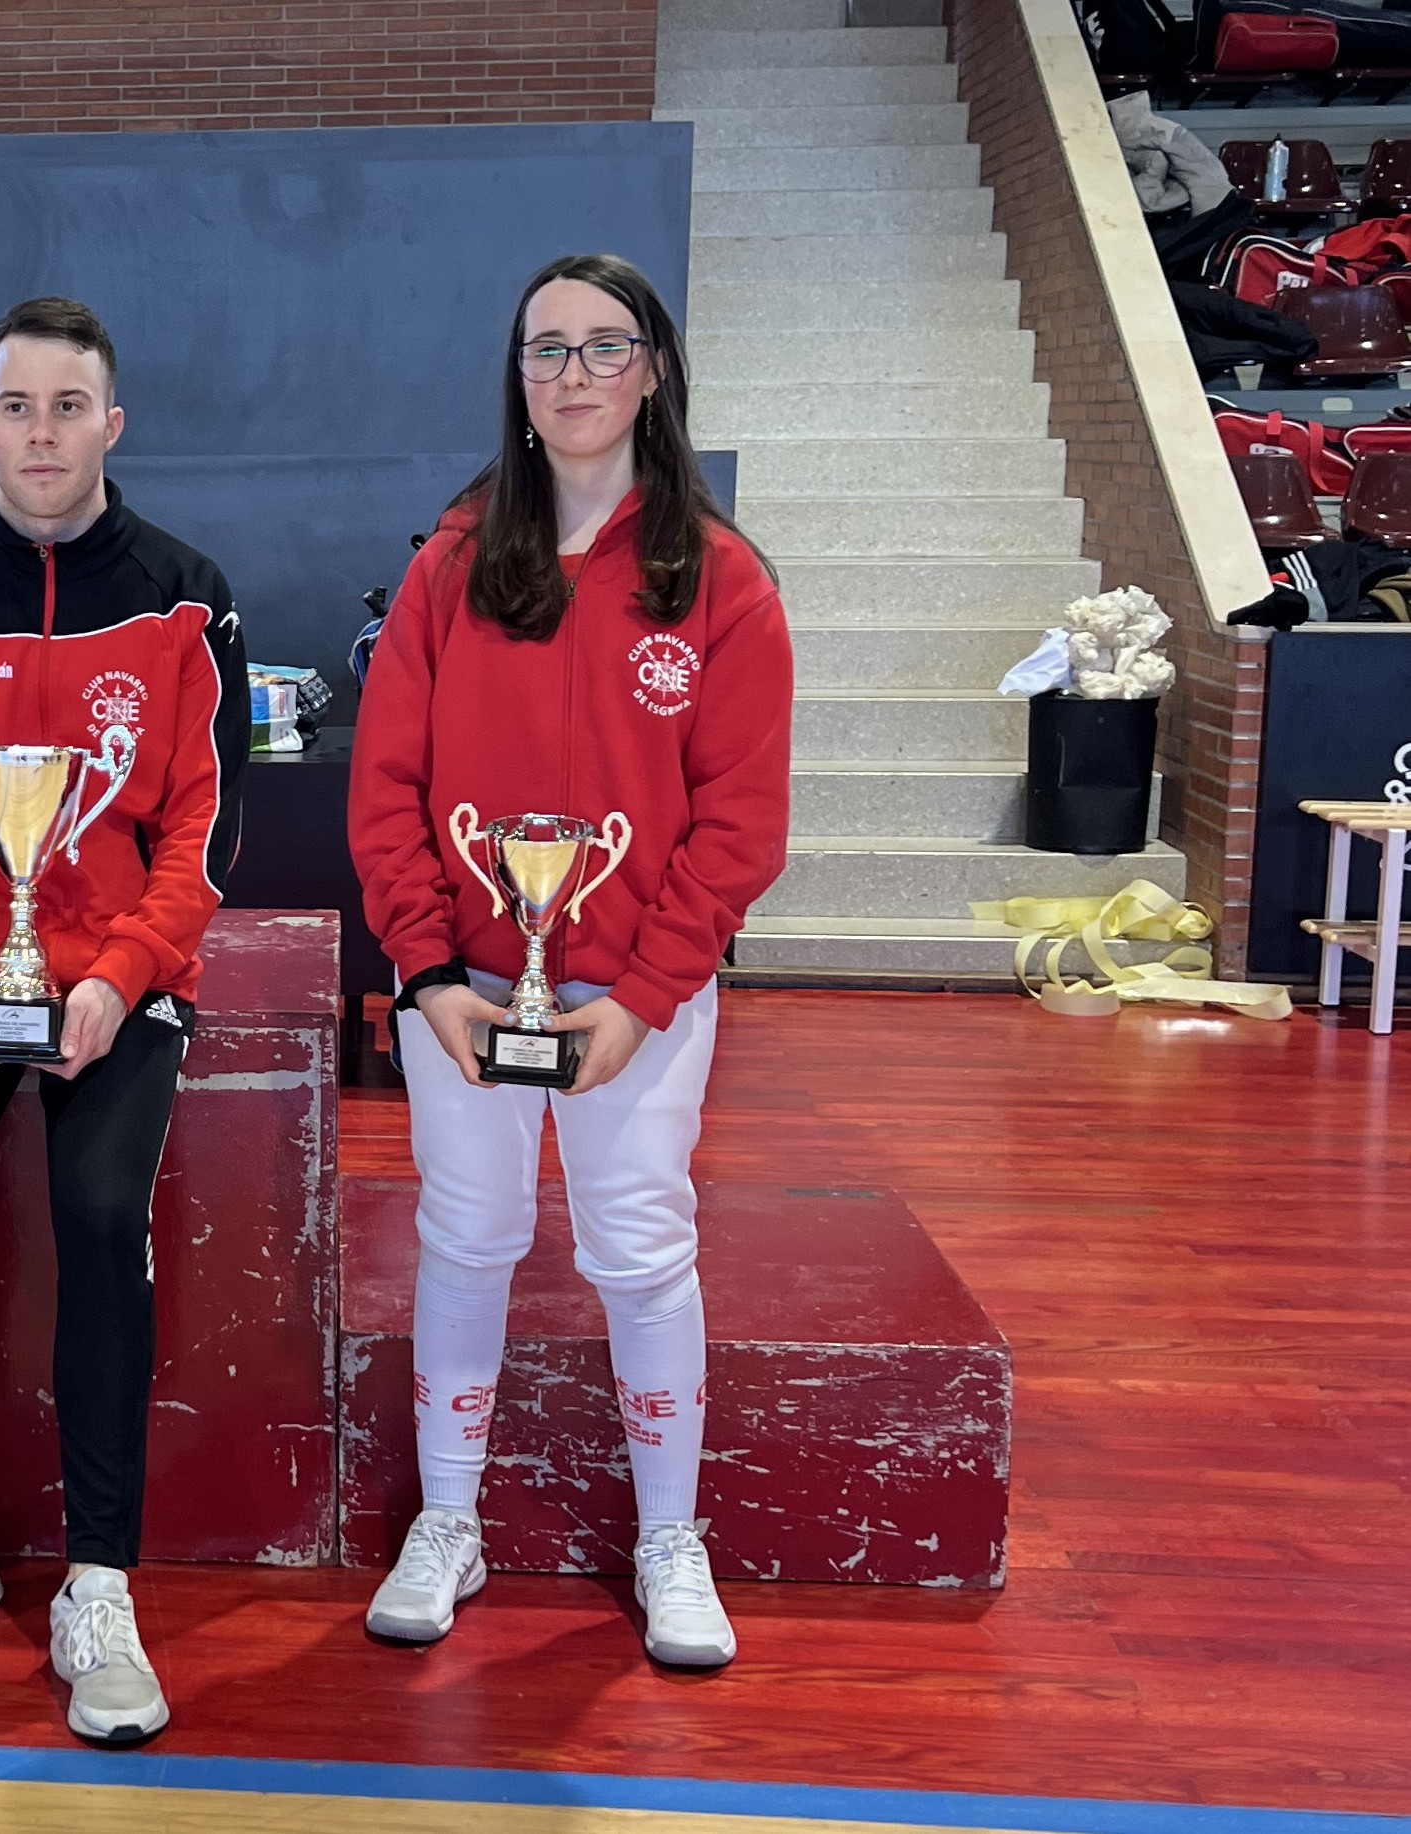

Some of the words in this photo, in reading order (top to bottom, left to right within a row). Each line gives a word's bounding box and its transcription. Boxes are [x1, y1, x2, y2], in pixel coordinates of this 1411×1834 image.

[628, 635, 653, 662] CLUB
[654, 633, 701, 671] NAVARRO
[81, 675, 104, 700] CLUB
[104, 670, 149, 701] NAVARRO
[632, 688, 648, 705] DE
[86, 723, 101, 738] DE
